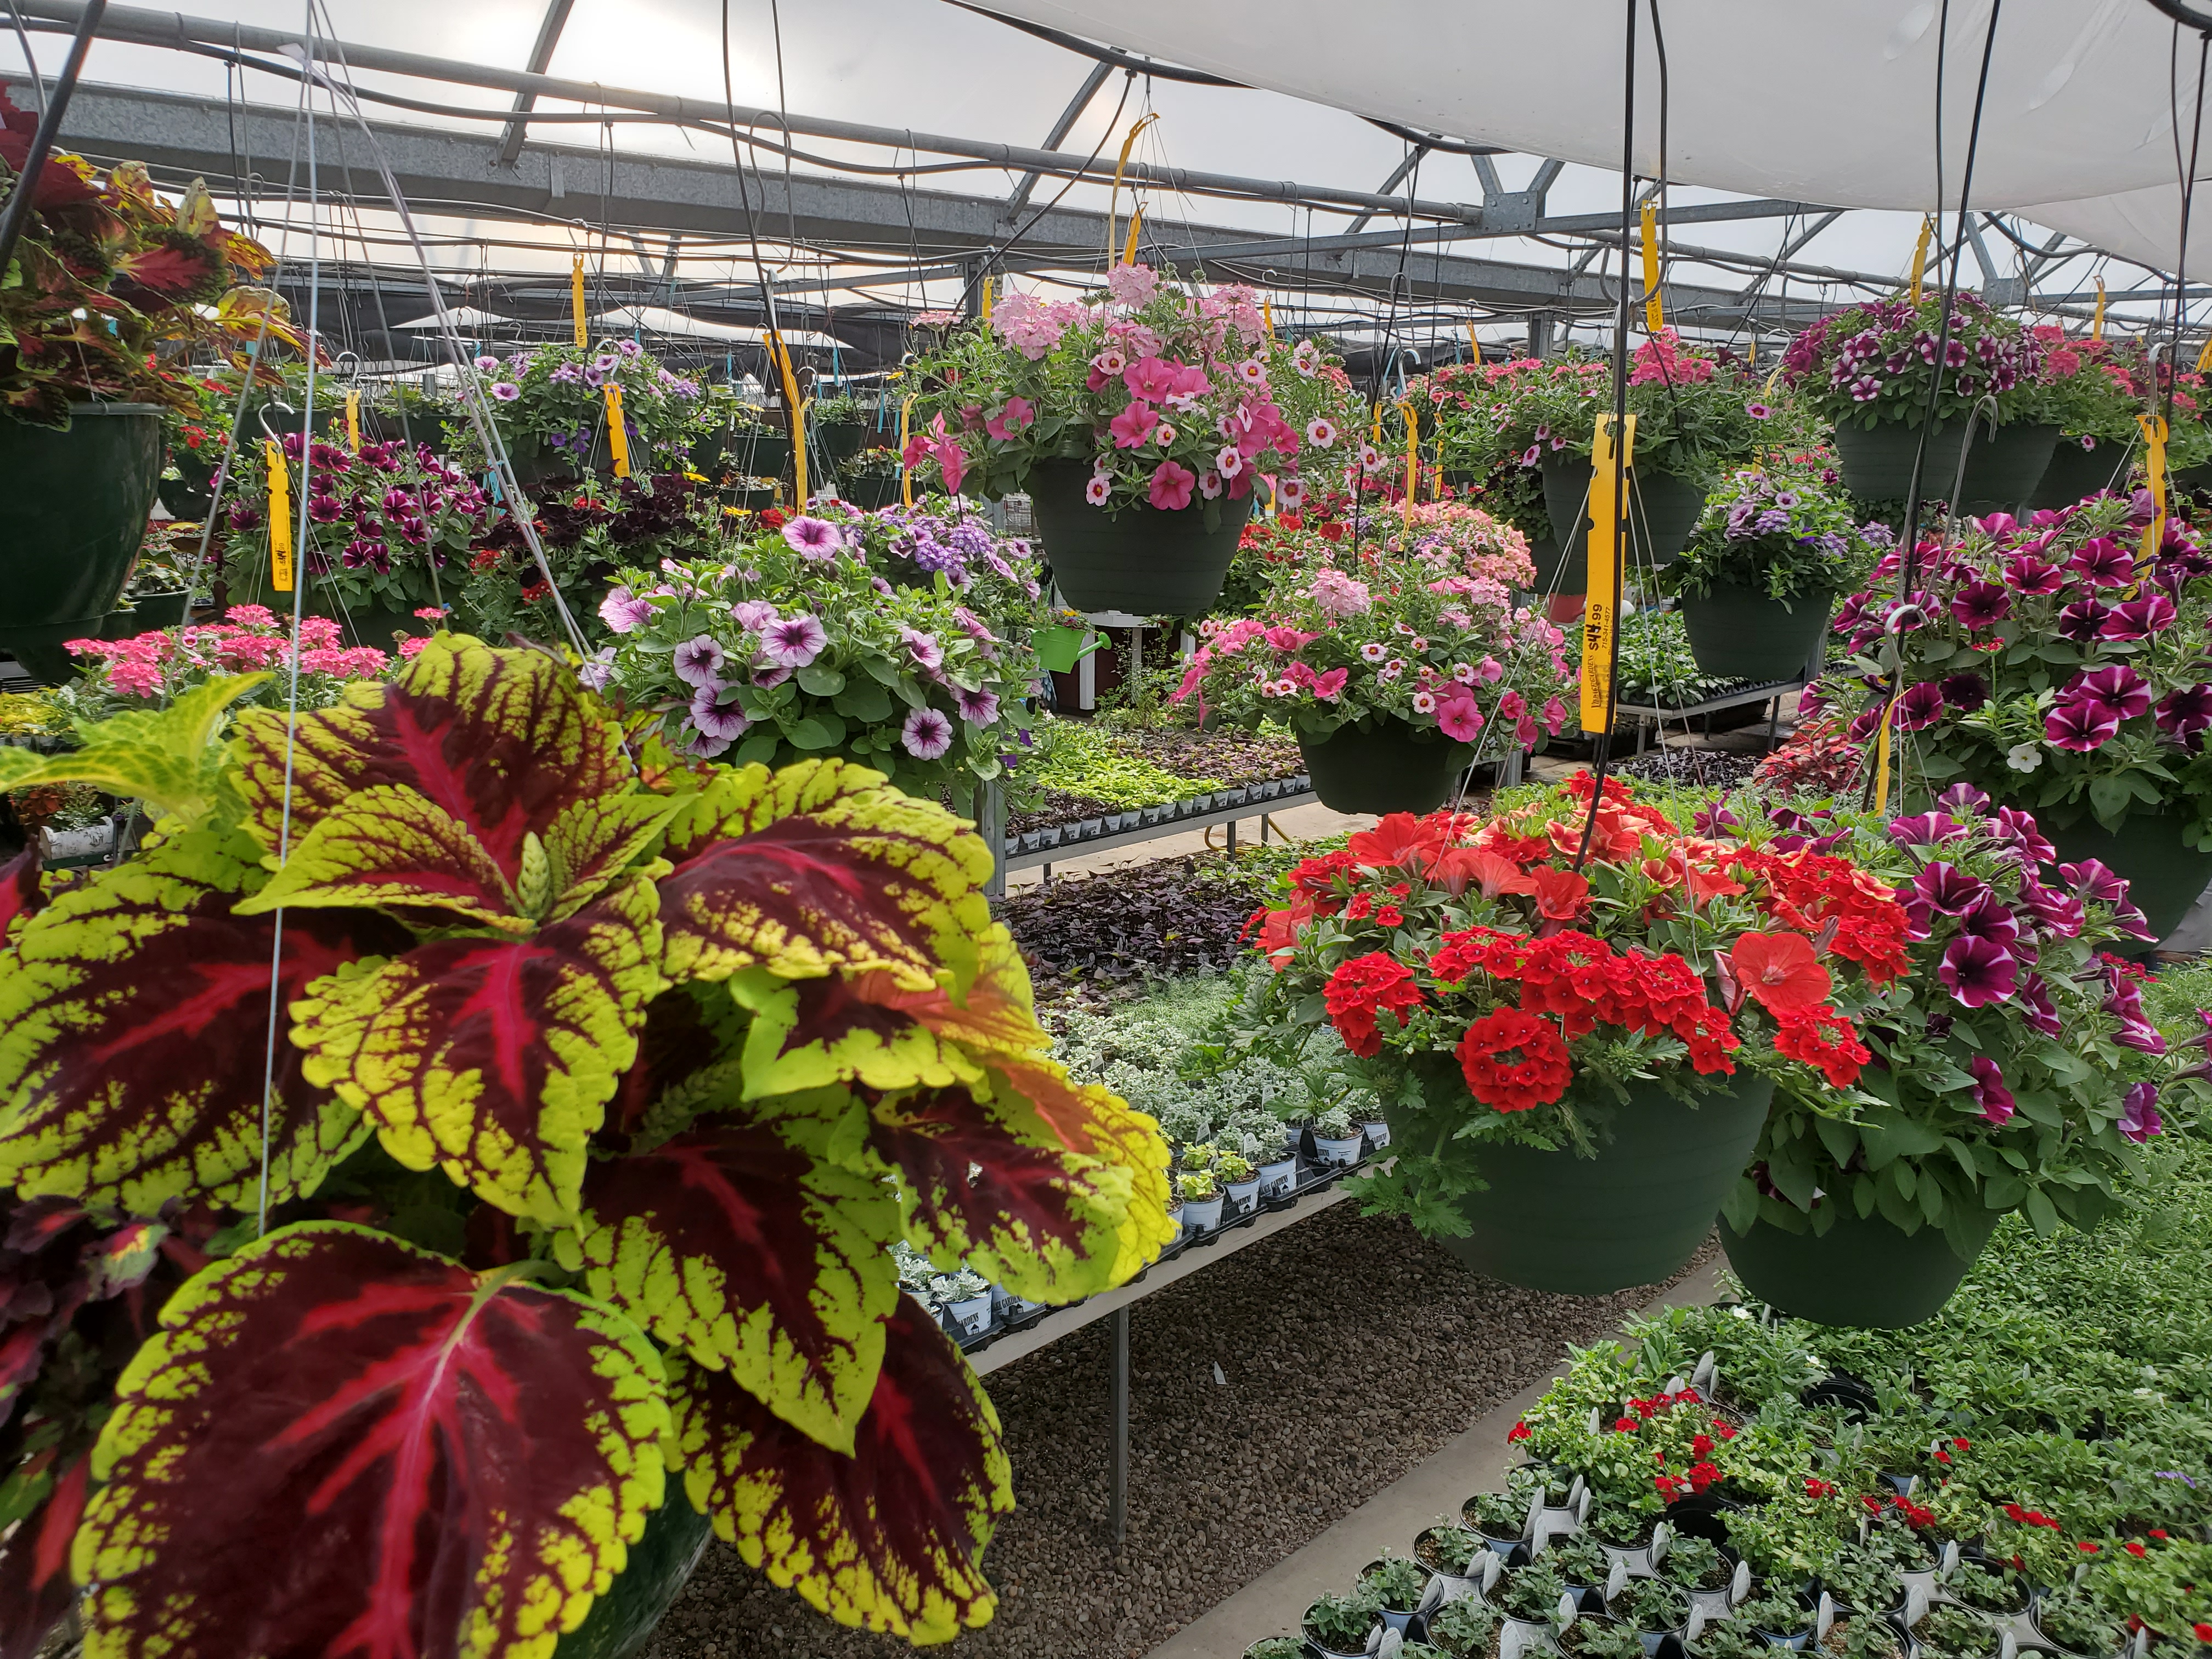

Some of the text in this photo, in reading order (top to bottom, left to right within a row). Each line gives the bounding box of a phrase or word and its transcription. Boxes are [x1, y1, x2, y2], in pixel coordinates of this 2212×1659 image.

[1585, 603, 1602, 651] $44.99
[1602, 606, 1611, 650] 715-341-4577
[1587, 654, 1601, 708] VILLAGE GARDENS
[1002, 1296, 1023, 1308] GARDENS
